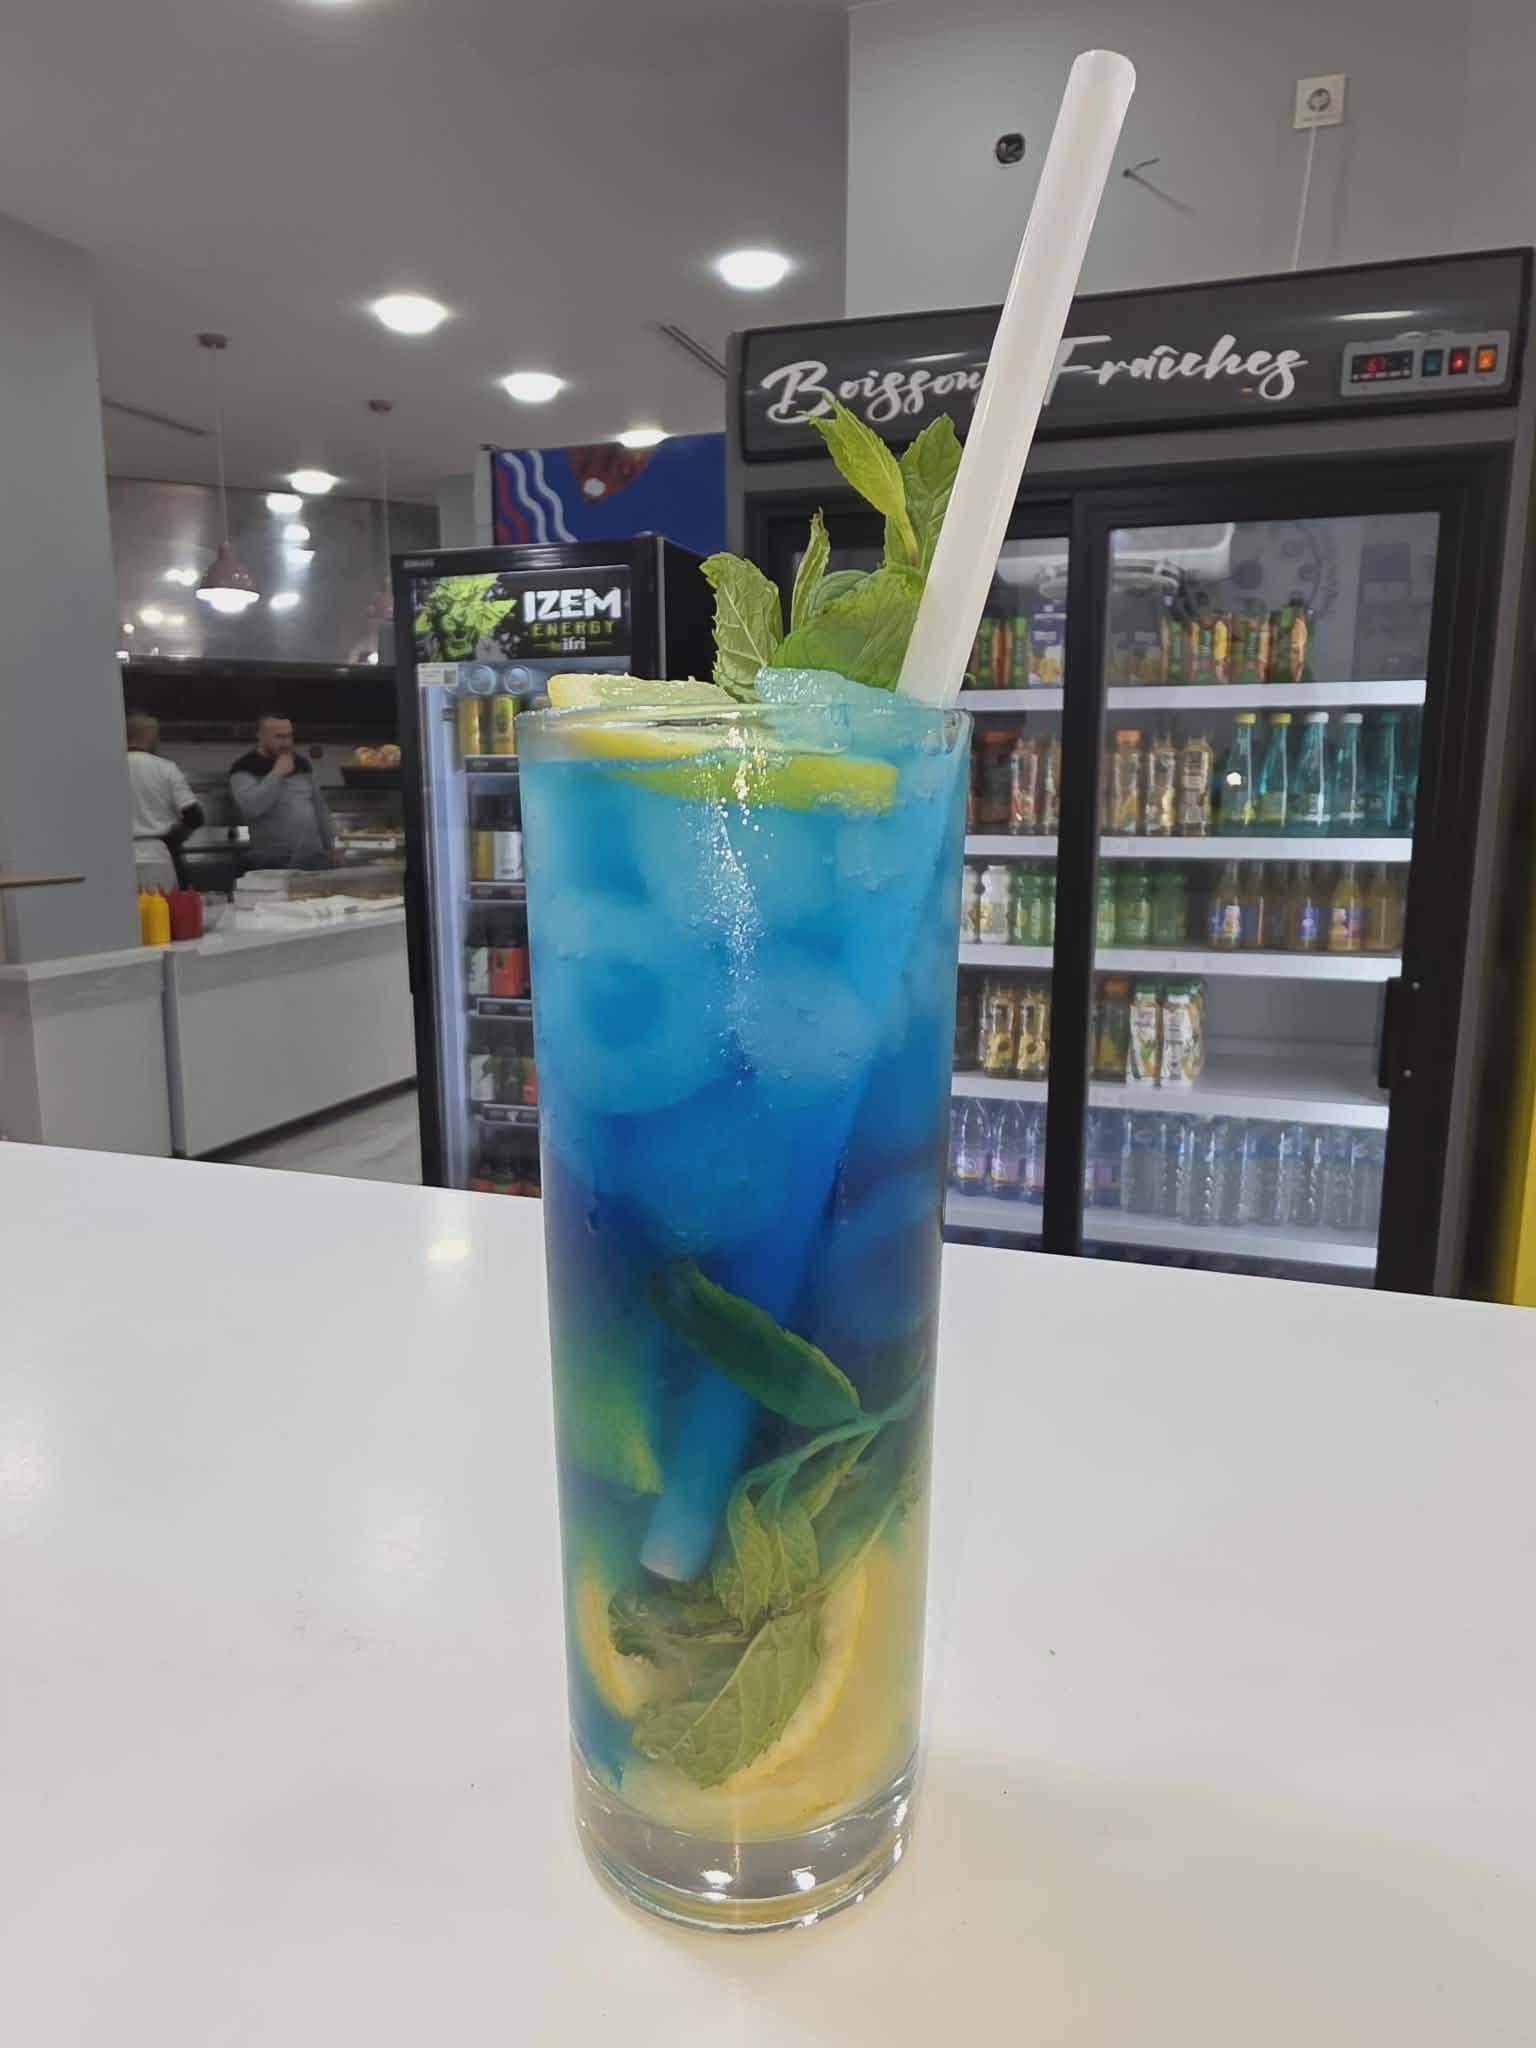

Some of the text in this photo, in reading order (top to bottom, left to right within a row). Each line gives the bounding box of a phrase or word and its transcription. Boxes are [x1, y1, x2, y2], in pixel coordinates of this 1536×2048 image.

[761, 334, 1308, 424] Boisson Fraîches
[523, 587, 622, 624] IZEM
[532, 621, 615, 637] ENERGY
[562, 637, 586, 651] ifri
